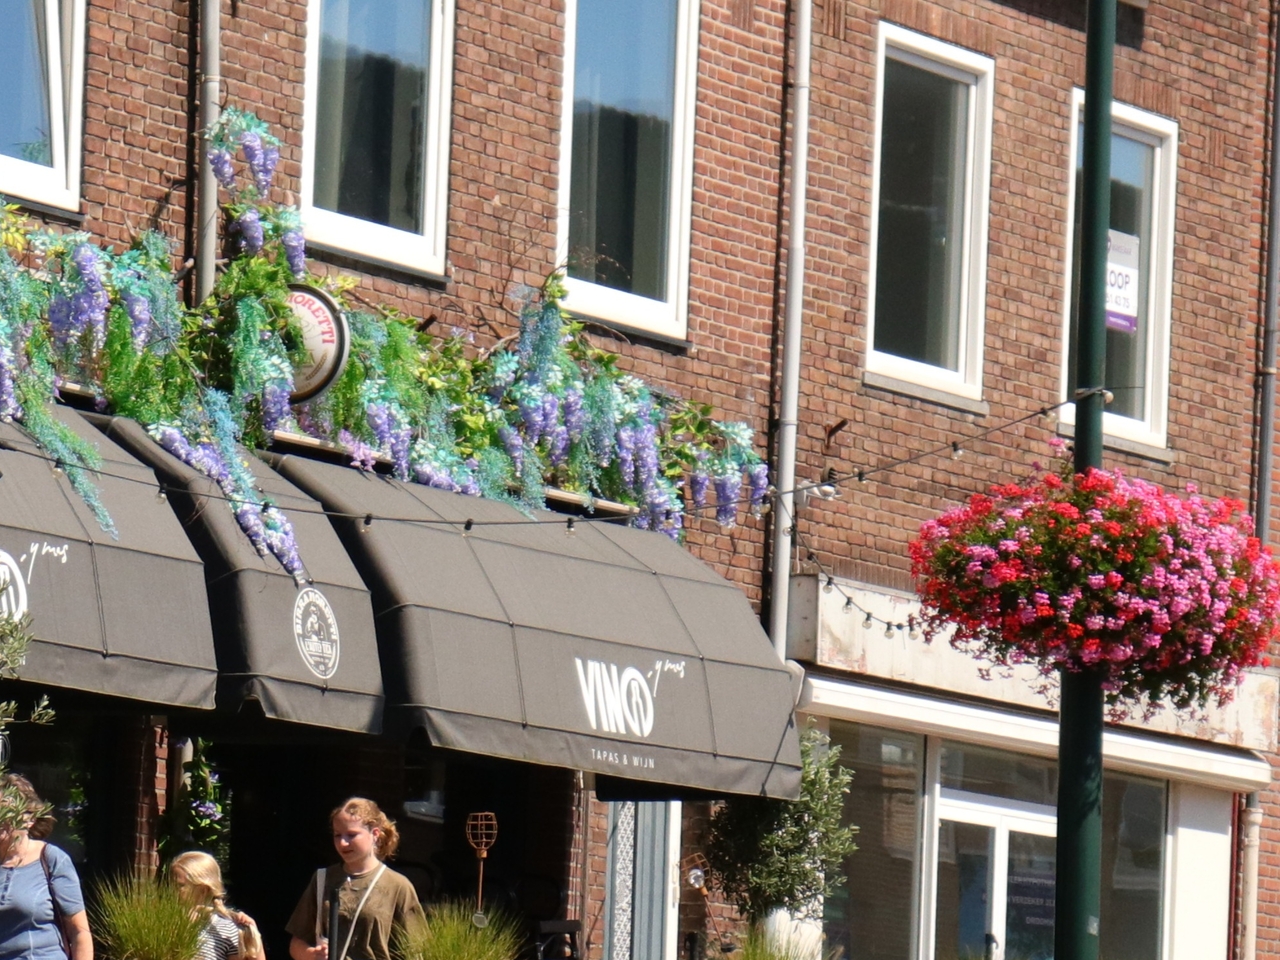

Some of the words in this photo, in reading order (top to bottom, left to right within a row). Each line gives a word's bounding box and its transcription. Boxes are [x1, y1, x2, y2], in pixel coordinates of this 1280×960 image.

[575, 657, 654, 738] VINO
[591, 748, 619, 764] TAPAS
[622, 754, 629, 766] &
[632, 755, 656, 769] WIJN
